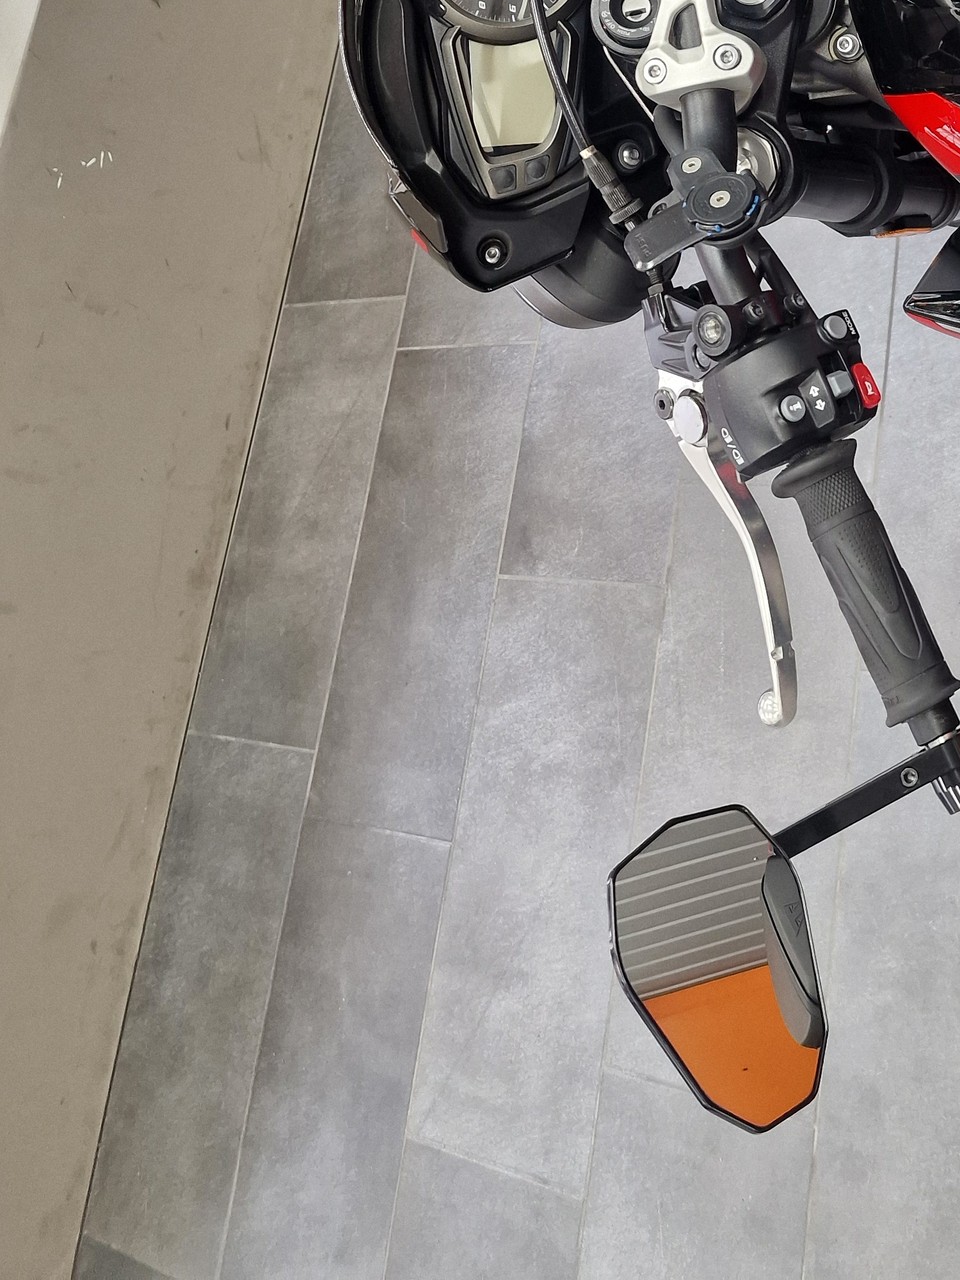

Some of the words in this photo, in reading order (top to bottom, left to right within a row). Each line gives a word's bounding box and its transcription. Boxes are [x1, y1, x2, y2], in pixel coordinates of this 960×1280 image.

[478, 0, 486, 9] 8
[509, 4, 516, 13] 6
[606, 18, 615, 29] OFF
[841, 310, 857, 335] MODE
